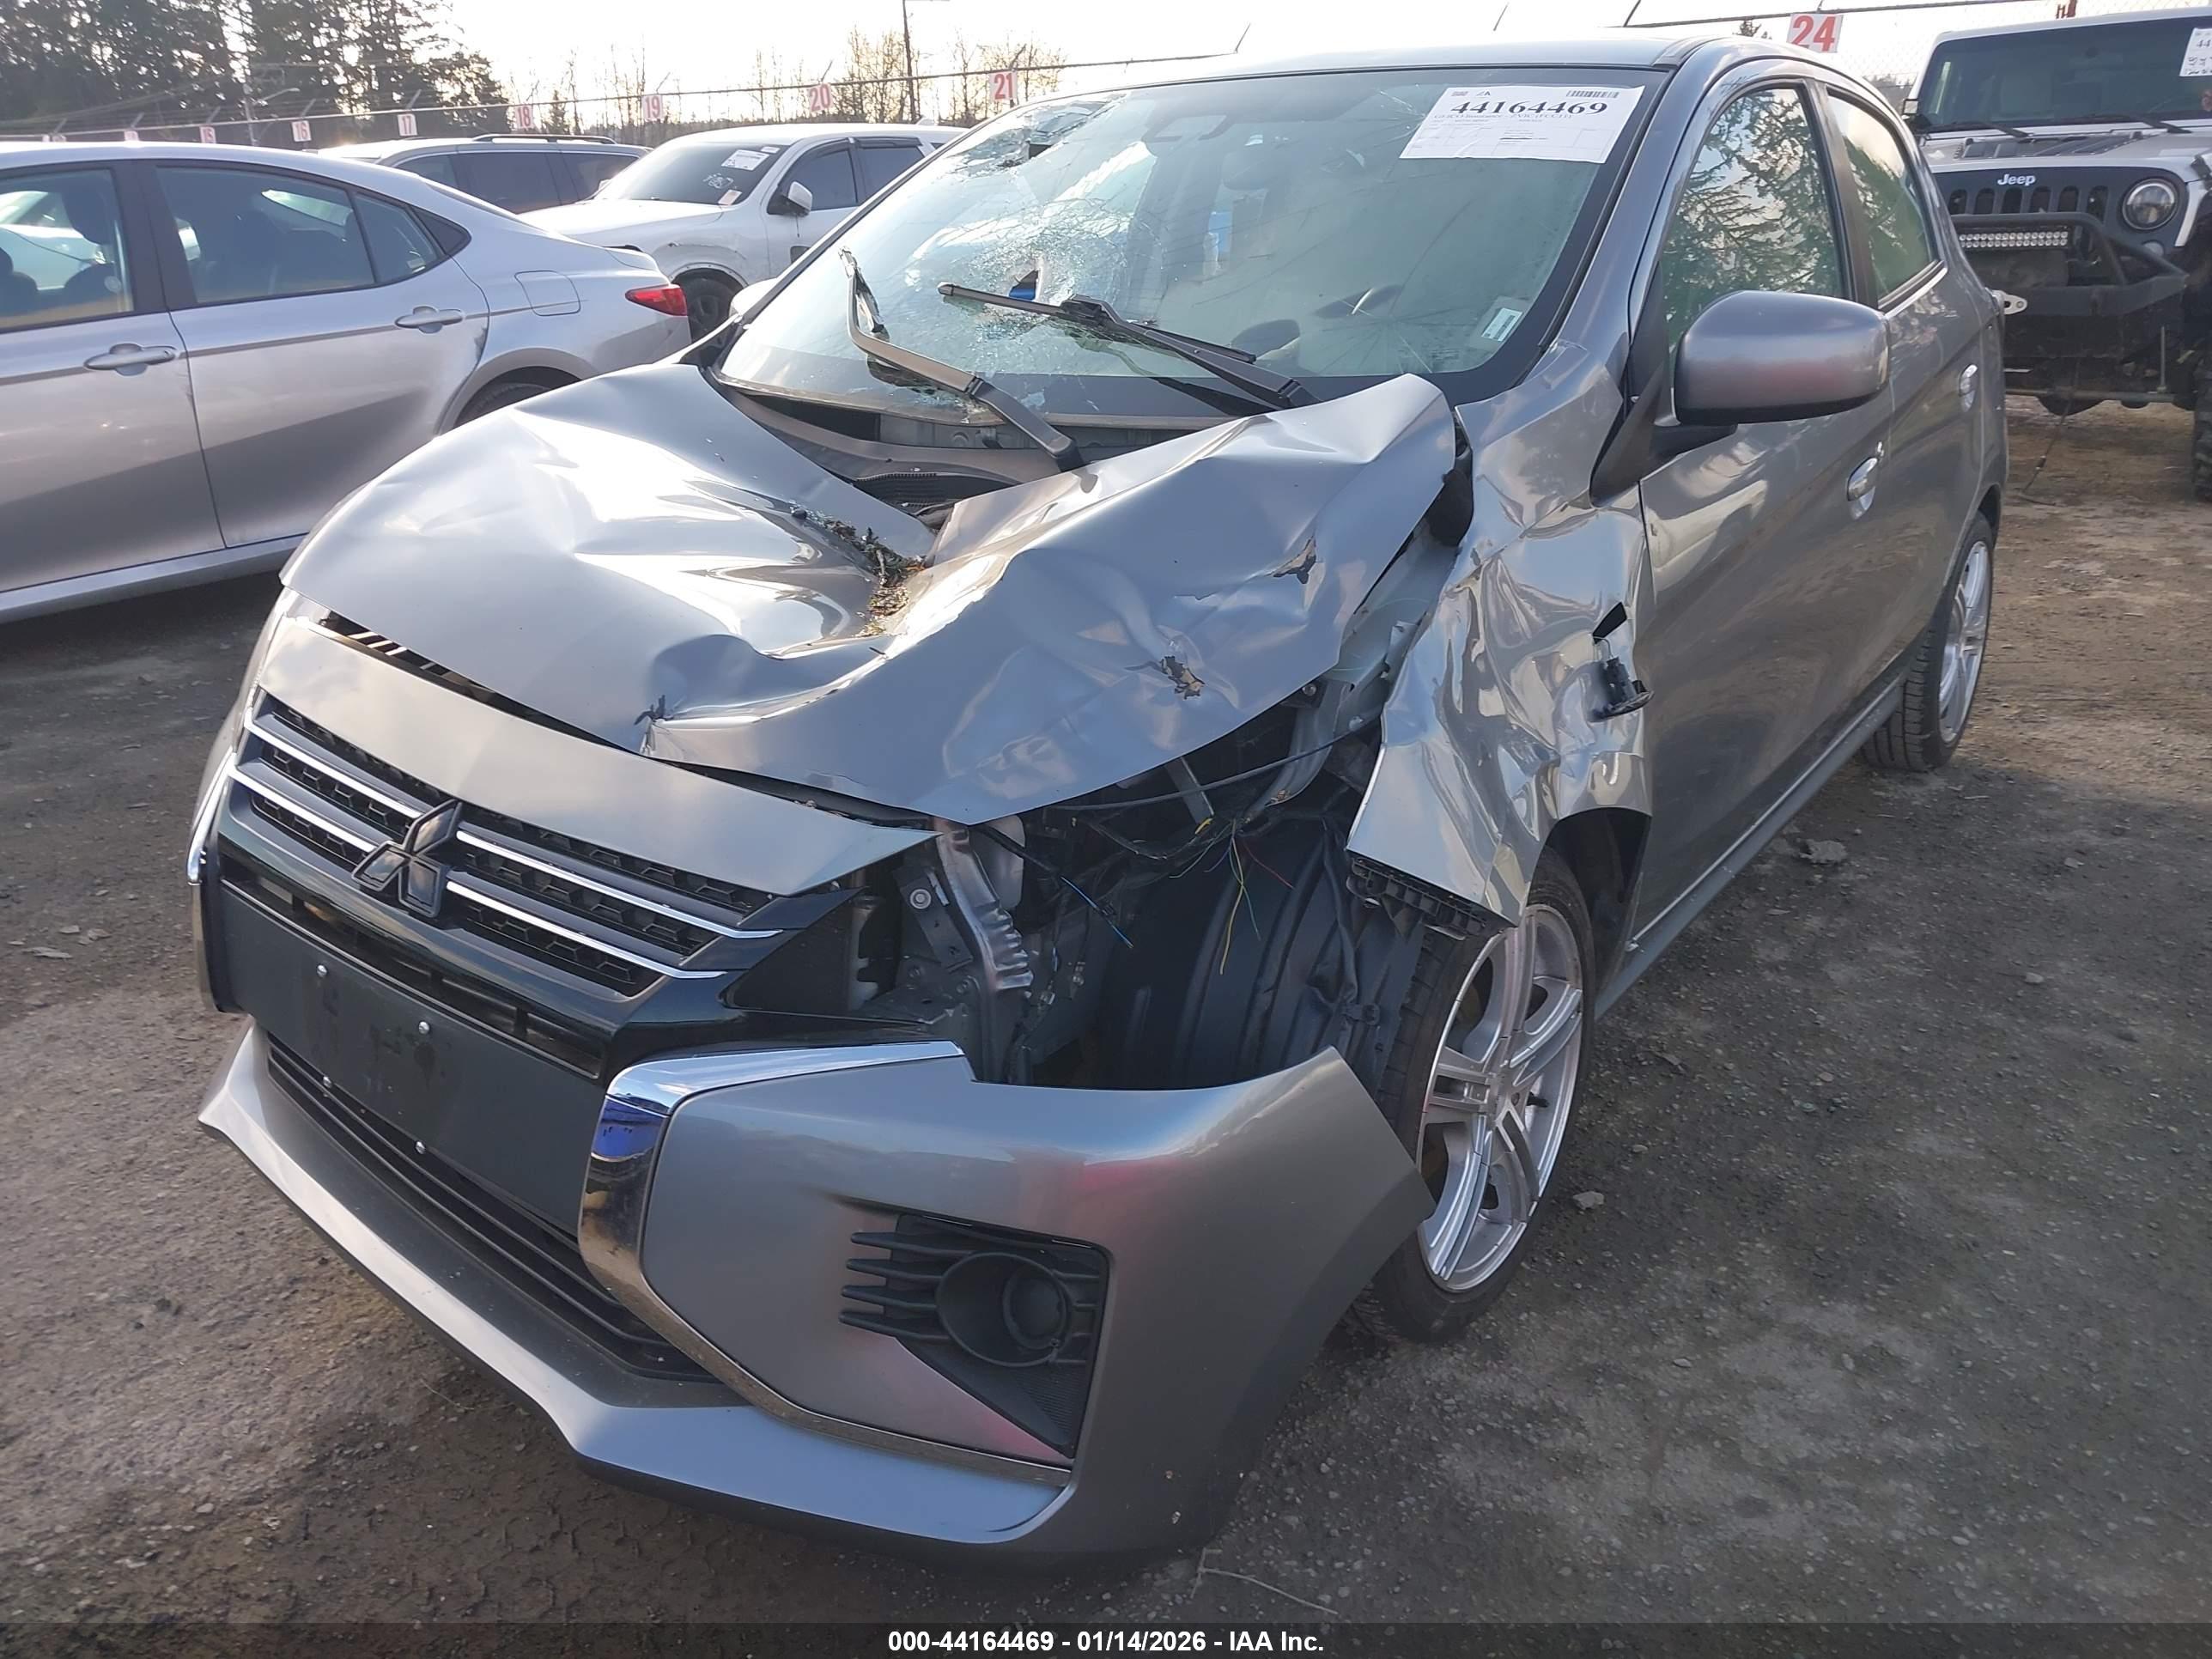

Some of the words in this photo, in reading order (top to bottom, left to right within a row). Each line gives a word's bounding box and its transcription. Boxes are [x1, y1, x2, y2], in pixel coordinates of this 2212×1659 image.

[1791, 15, 1836, 52] 24
[994, 72, 1013, 100] 21
[645, 95, 660, 118] 19
[809, 84, 831, 112] 20
[1450, 101, 1607, 114] 44164469
[402, 115, 412, 134] 17
[517, 106, 531, 127] 18
[295, 118, 308, 140] 16
[1996, 173, 2036, 186] Jeep
